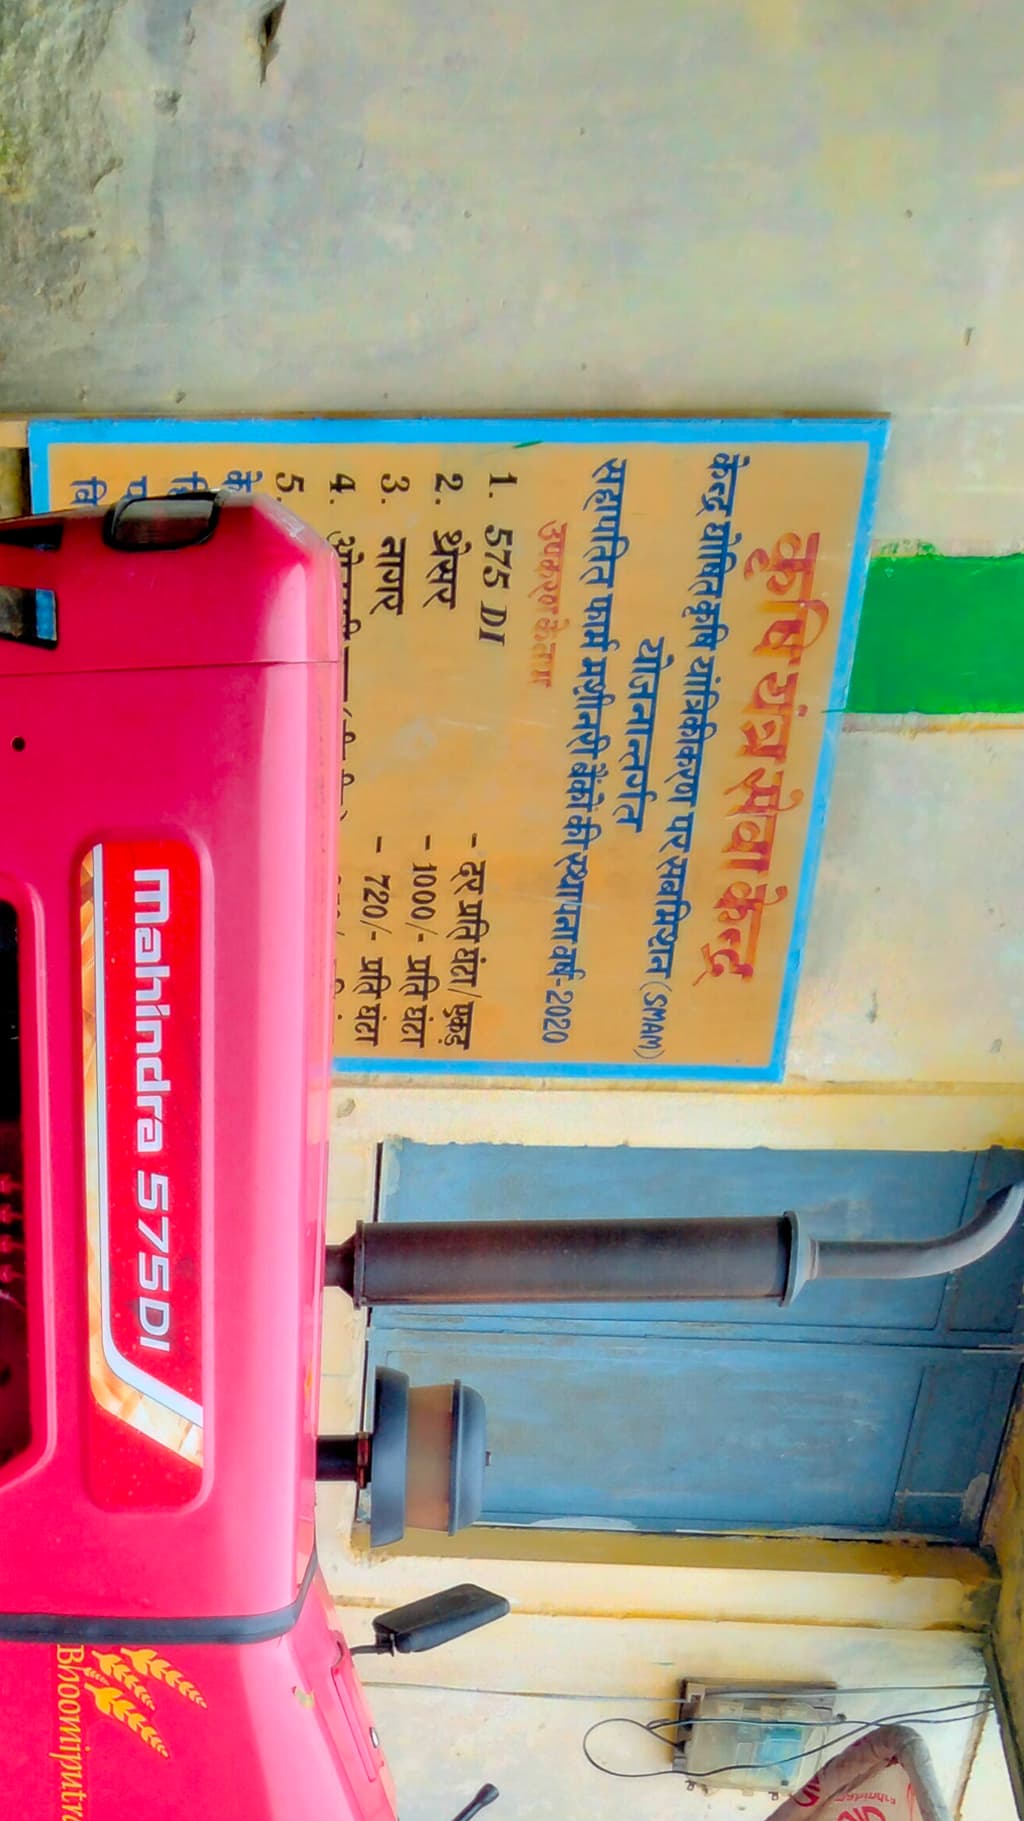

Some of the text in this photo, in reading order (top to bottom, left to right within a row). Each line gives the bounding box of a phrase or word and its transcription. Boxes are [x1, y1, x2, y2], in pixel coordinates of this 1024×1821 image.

[329, 473, 357, 505] 4.
[696, 453, 750, 517] केन्द्र
[369, 473, 411, 616] 3. नागर
[422, 473, 472, 611] 2. थ्रेसर
[478, 472, 518, 647] 1. 575 DI
[532, 616, 570, 643] के
[580, 593, 620, 652] फार्म
[682, 600, 729, 652] कृषि
[566, 656, 616, 761] मशीनरी
[612, 636, 675, 833] योजनान्तर्गत
[664, 656, 721, 808] यांत्रिकीकरण
[693, 532, 829, 986] कृषि यंत्र सेवा केन्द्र
[561, 816, 602, 852] की
[659, 812, 695, 853] पर
[359, 874, 393, 941] 720/-
[404, 862, 439, 943] 1000/-
[450, 860, 487, 896] दर
[554, 852, 589, 944] स्थापना
[445, 900, 490, 945] प्रति
[646, 856, 692, 979] सबमिशन
[351, 956, 392, 1000] प्रति
[398, 954, 441, 1001] प्रति
[134, 868, 172, 1153] Mahindra
[354, 1003, 387, 1047] घंटा
[400, 1004, 434, 1049] घंटा
[633, 982, 673, 1060] (SMAM)
